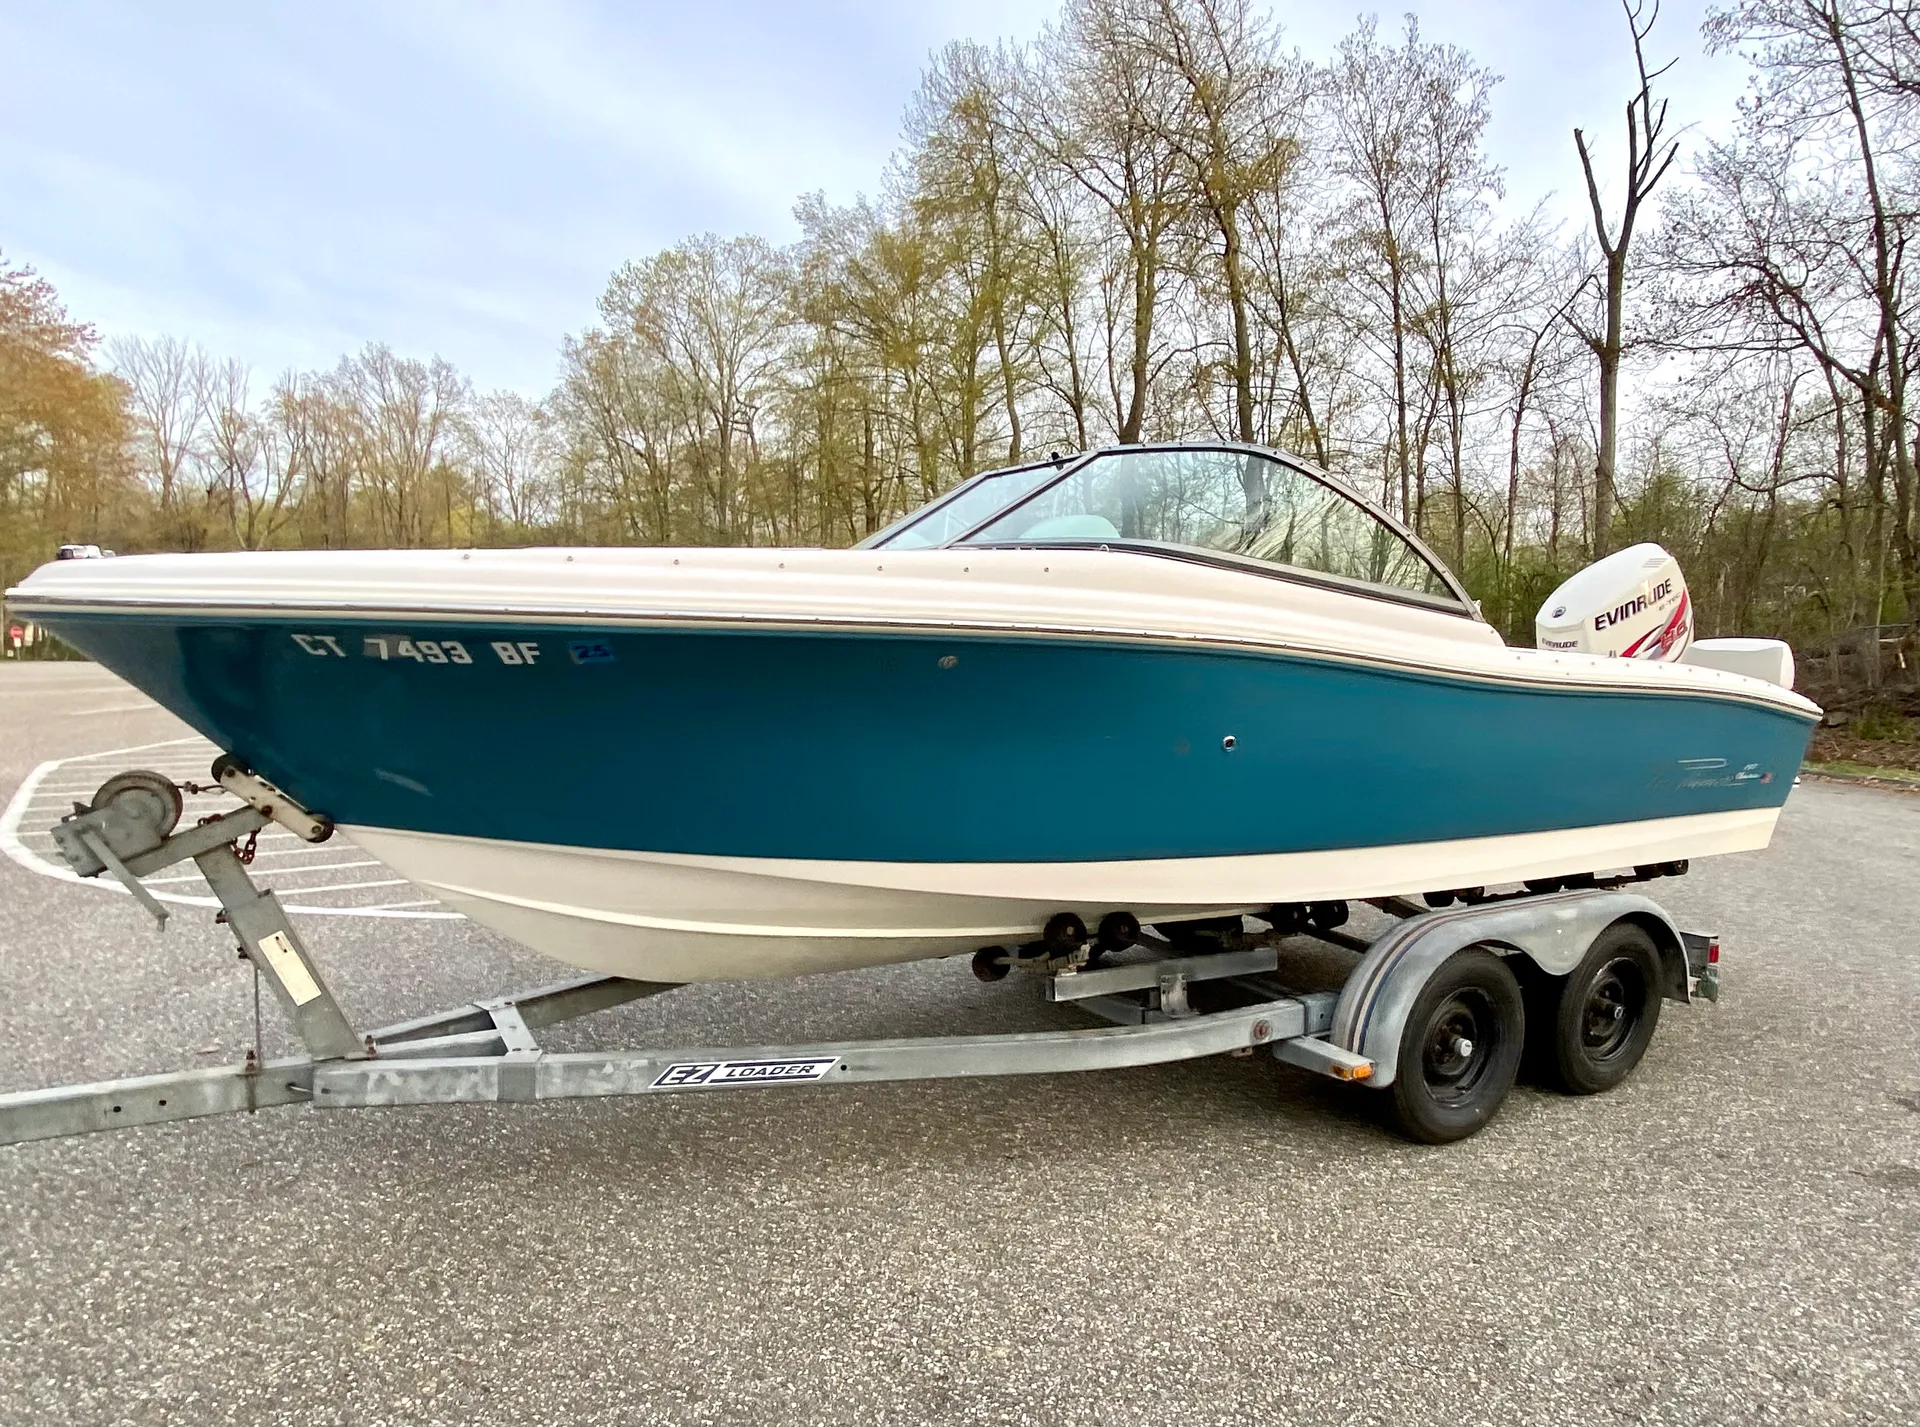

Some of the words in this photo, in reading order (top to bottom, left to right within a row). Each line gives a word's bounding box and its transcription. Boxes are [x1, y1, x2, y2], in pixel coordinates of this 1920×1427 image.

[1594, 578, 1672, 631] EVINRUDE
[291, 634, 346, 657] CT
[364, 638, 474, 664] 7493
[491, 641, 540, 664] BF
[660, 1065, 710, 1085] EZ
[725, 1065, 815, 1078] LOADER
